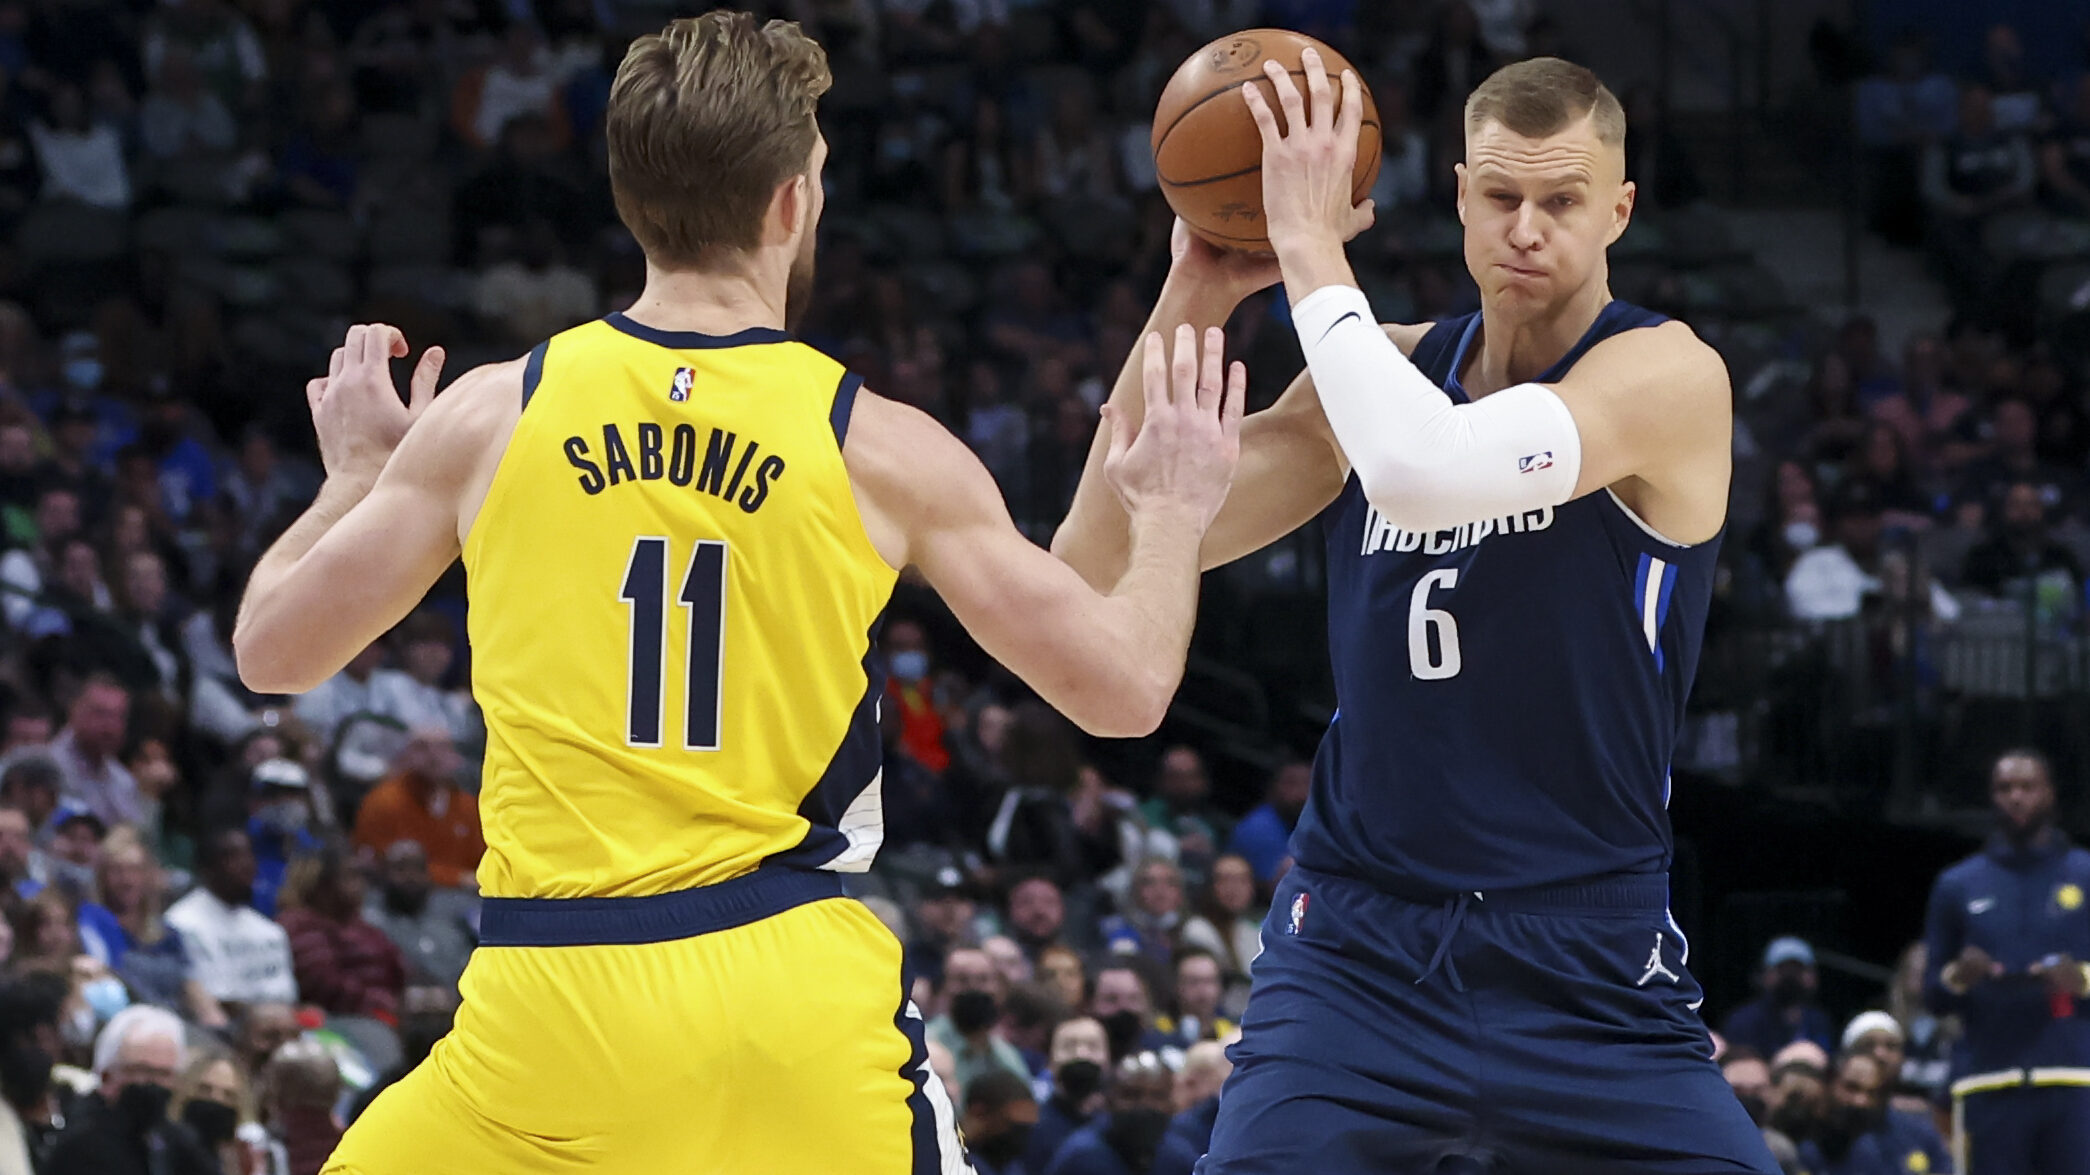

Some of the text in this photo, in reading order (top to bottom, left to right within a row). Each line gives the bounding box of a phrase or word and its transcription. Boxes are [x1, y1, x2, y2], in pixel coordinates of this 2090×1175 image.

[563, 422, 785, 514] SABONIS
[618, 535, 729, 752] 11
[1408, 568, 1461, 680] 6
